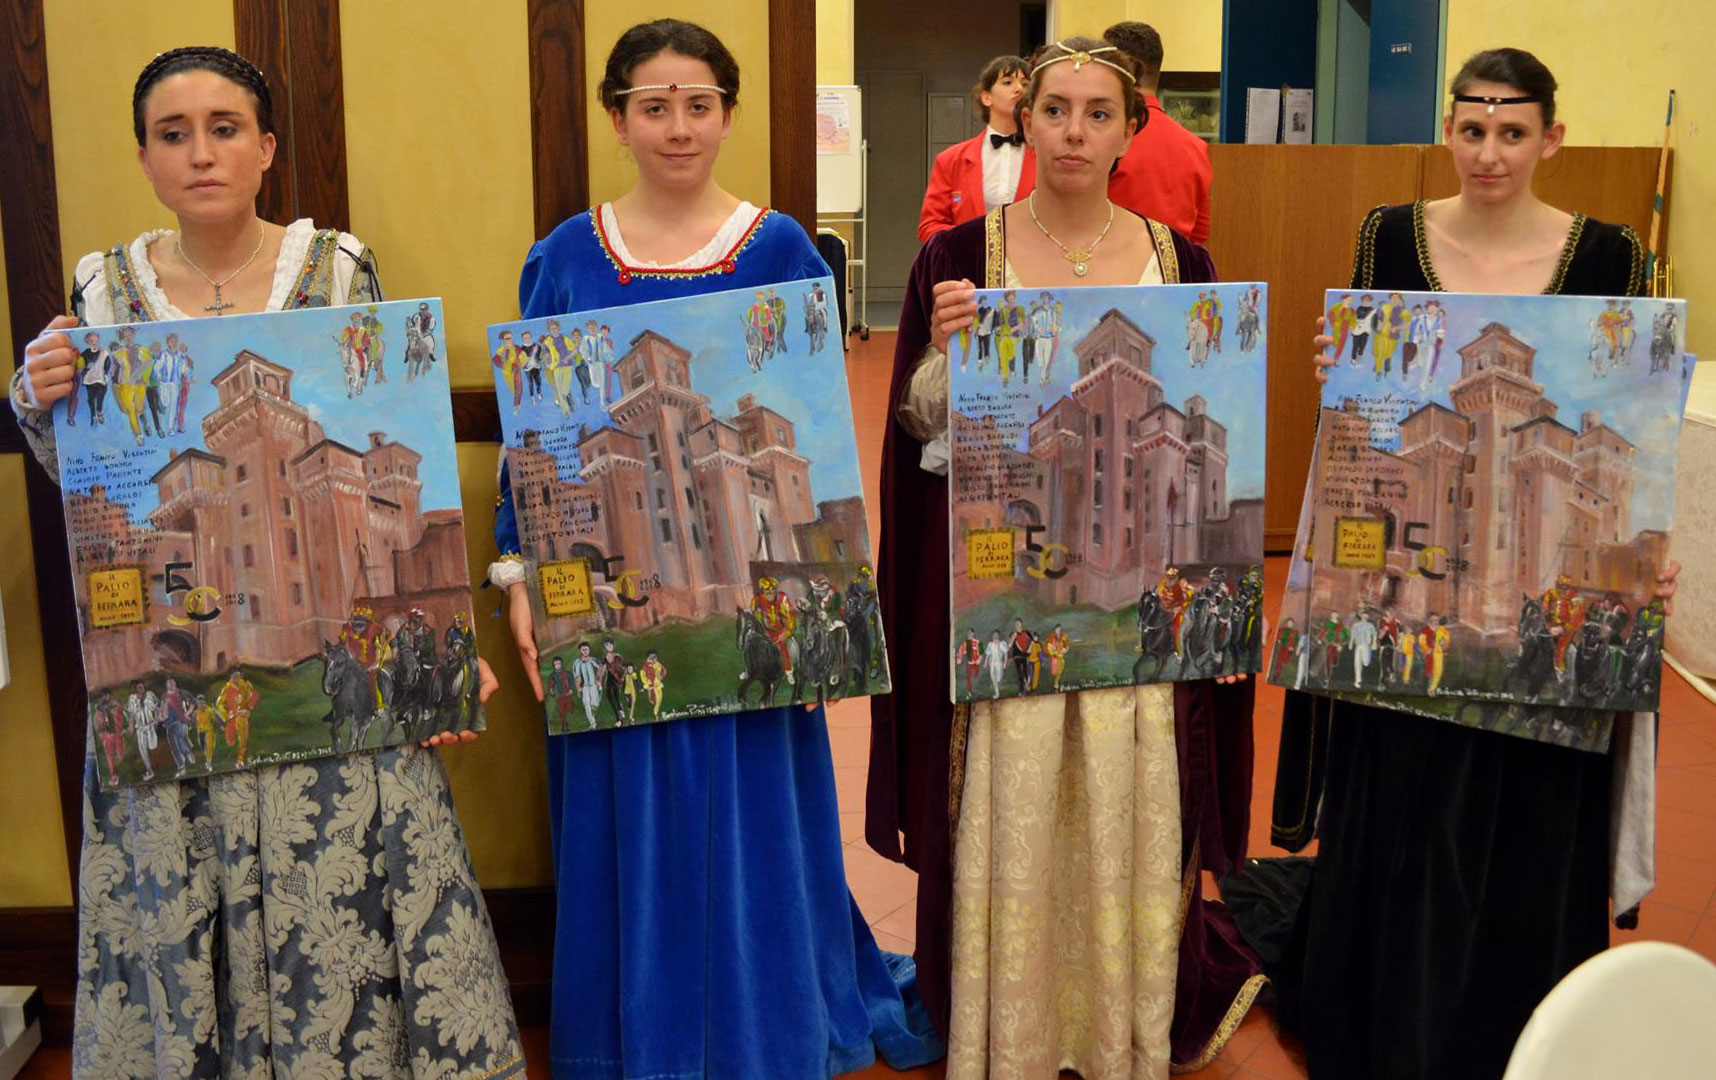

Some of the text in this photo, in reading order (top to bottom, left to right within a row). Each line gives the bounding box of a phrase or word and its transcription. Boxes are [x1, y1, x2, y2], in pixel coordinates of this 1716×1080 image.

[975, 541, 1009, 552] PALIO
[975, 555, 1009, 564] FERRARA
[547, 574, 575, 586] PALIO
[96, 581, 130, 594] PALIO
[549, 588, 584, 599] FERRARA
[97, 599, 138, 611] FERRARA
